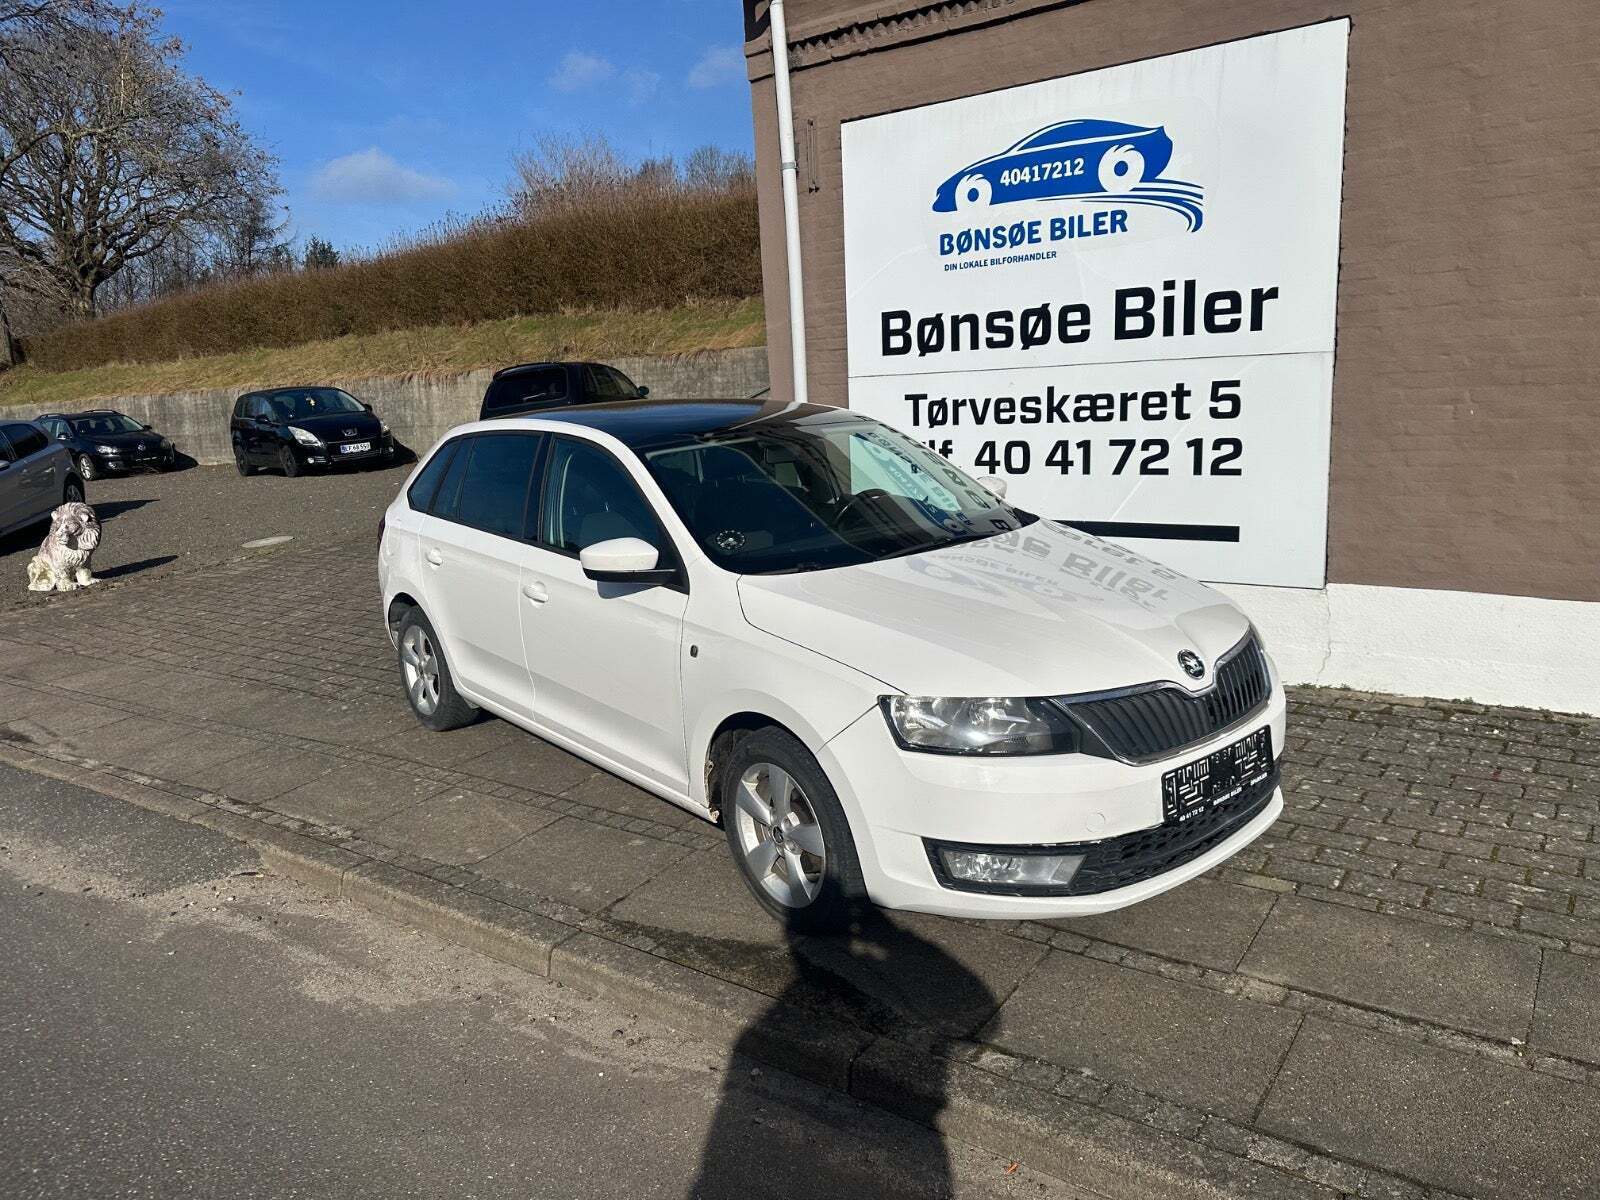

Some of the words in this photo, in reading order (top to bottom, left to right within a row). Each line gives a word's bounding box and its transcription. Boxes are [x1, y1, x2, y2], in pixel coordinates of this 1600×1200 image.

[1000, 157, 1085, 187] 40417212
[939, 220, 1042, 256] BØNSØE
[1049, 209, 1129, 242] BILER
[944, 263, 958, 272] DIN
[959, 259, 989, 270] LOKALE
[990, 251, 1057, 266] BILFORHANDLER
[881, 303, 1091, 357] Bønsøe
[1114, 279, 1279, 340] Biler
[904, 383, 1192, 429] Tørveskæret
[1209, 379, 1242, 421] 5
[974, 440, 1031, 475] 40
[1045, 439, 1091, 475] 41
[1109, 438, 1169, 476] 72
[1186, 437, 1243, 476] 12
